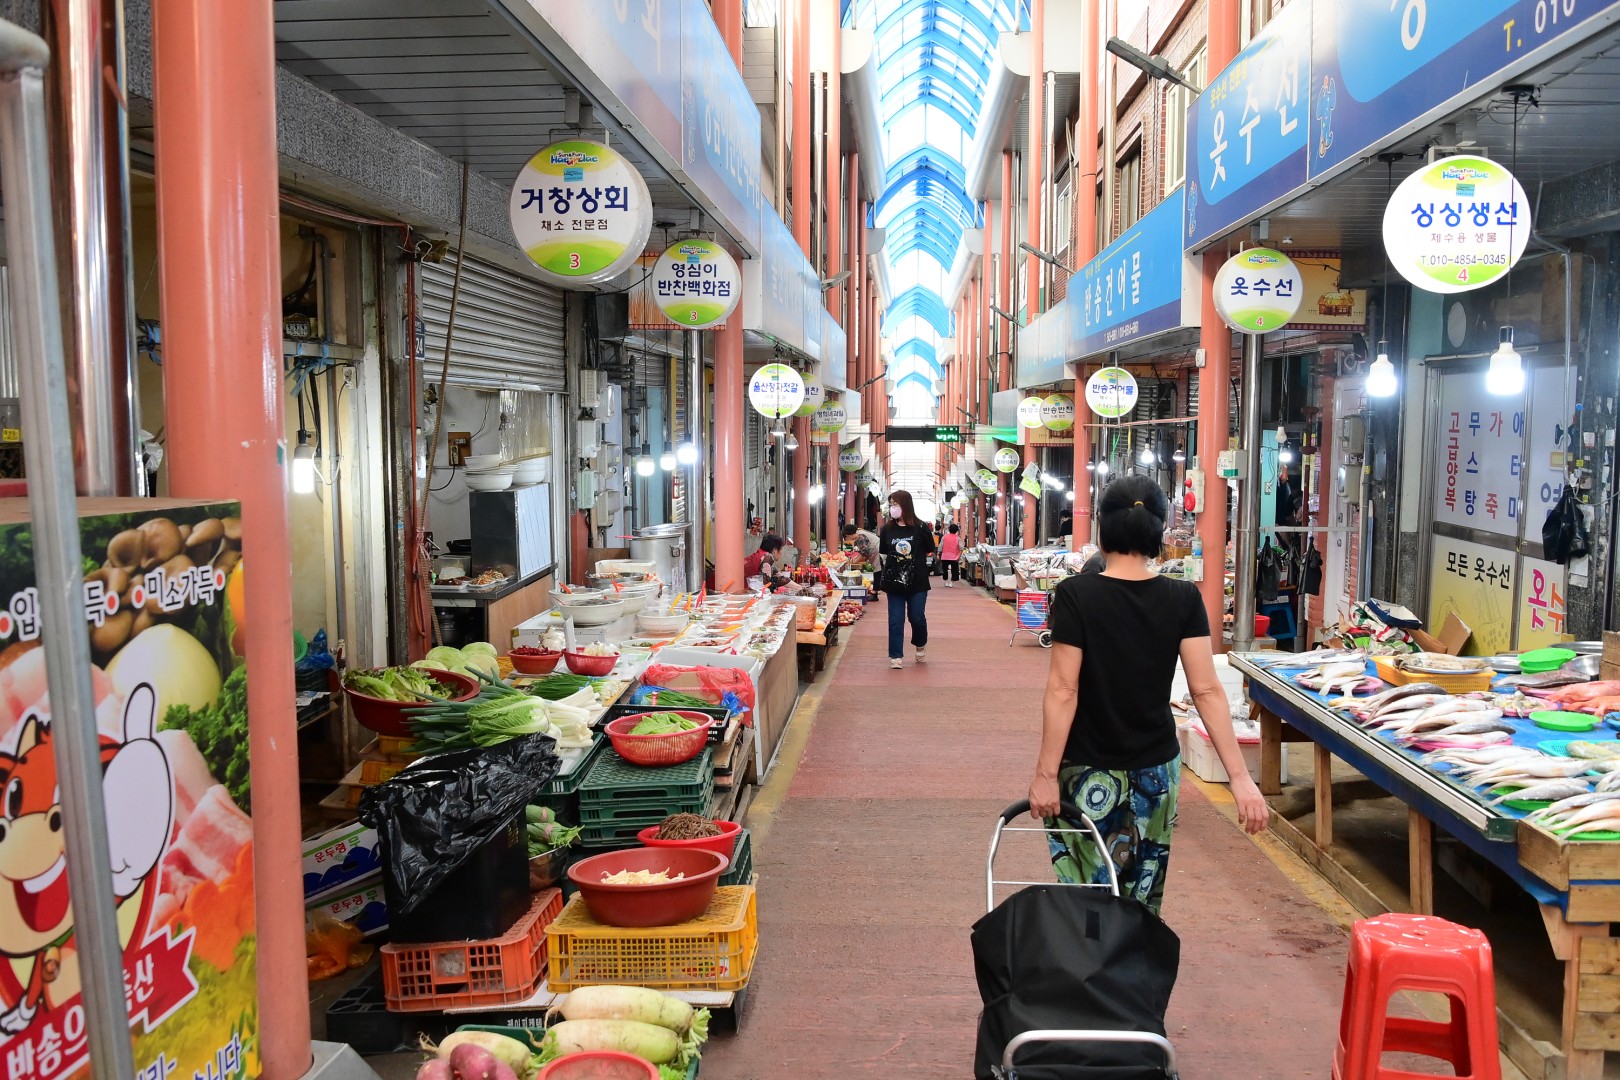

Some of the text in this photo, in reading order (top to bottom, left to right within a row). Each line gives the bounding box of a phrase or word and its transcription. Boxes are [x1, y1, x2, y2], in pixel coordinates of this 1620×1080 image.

[1504, 20, 1522, 51] T.
[1210, 52, 1299, 191] 옷수선
[550, 154, 599, 165] Haeundae
[521, 186, 629, 214] 거창상회
[1411, 202, 1518, 228] 싱싱생선
[541, 219, 608, 231] 채소 전문점
[1431, 232, 1497, 243] 제수용 생물
[570, 254, 580, 268] 3
[1420, 254, 1506, 265] T.010-4854-0345
[671, 263, 717, 278] 영심이
[1458, 268, 1467, 281] 4
[658, 280, 731, 297] 반찬백화점
[1084, 250, 1141, 328] 반송건어물
[1231, 277, 1293, 297] 옷수선
[690, 311, 698, 321] 3
[1256, 317, 1264, 326] 4
[1092, 383, 1134, 396] 반송건어물
[1042, 405, 1073, 415] 반송반찬
[1445, 411, 1460, 512] 고급양복
[1464, 411, 1480, 516] 무스탕
[1484, 411, 1503, 519] 가죽
[1446, 551, 1511, 590] 모든 옷수선
[147, 567, 214, 609] 미소가득
